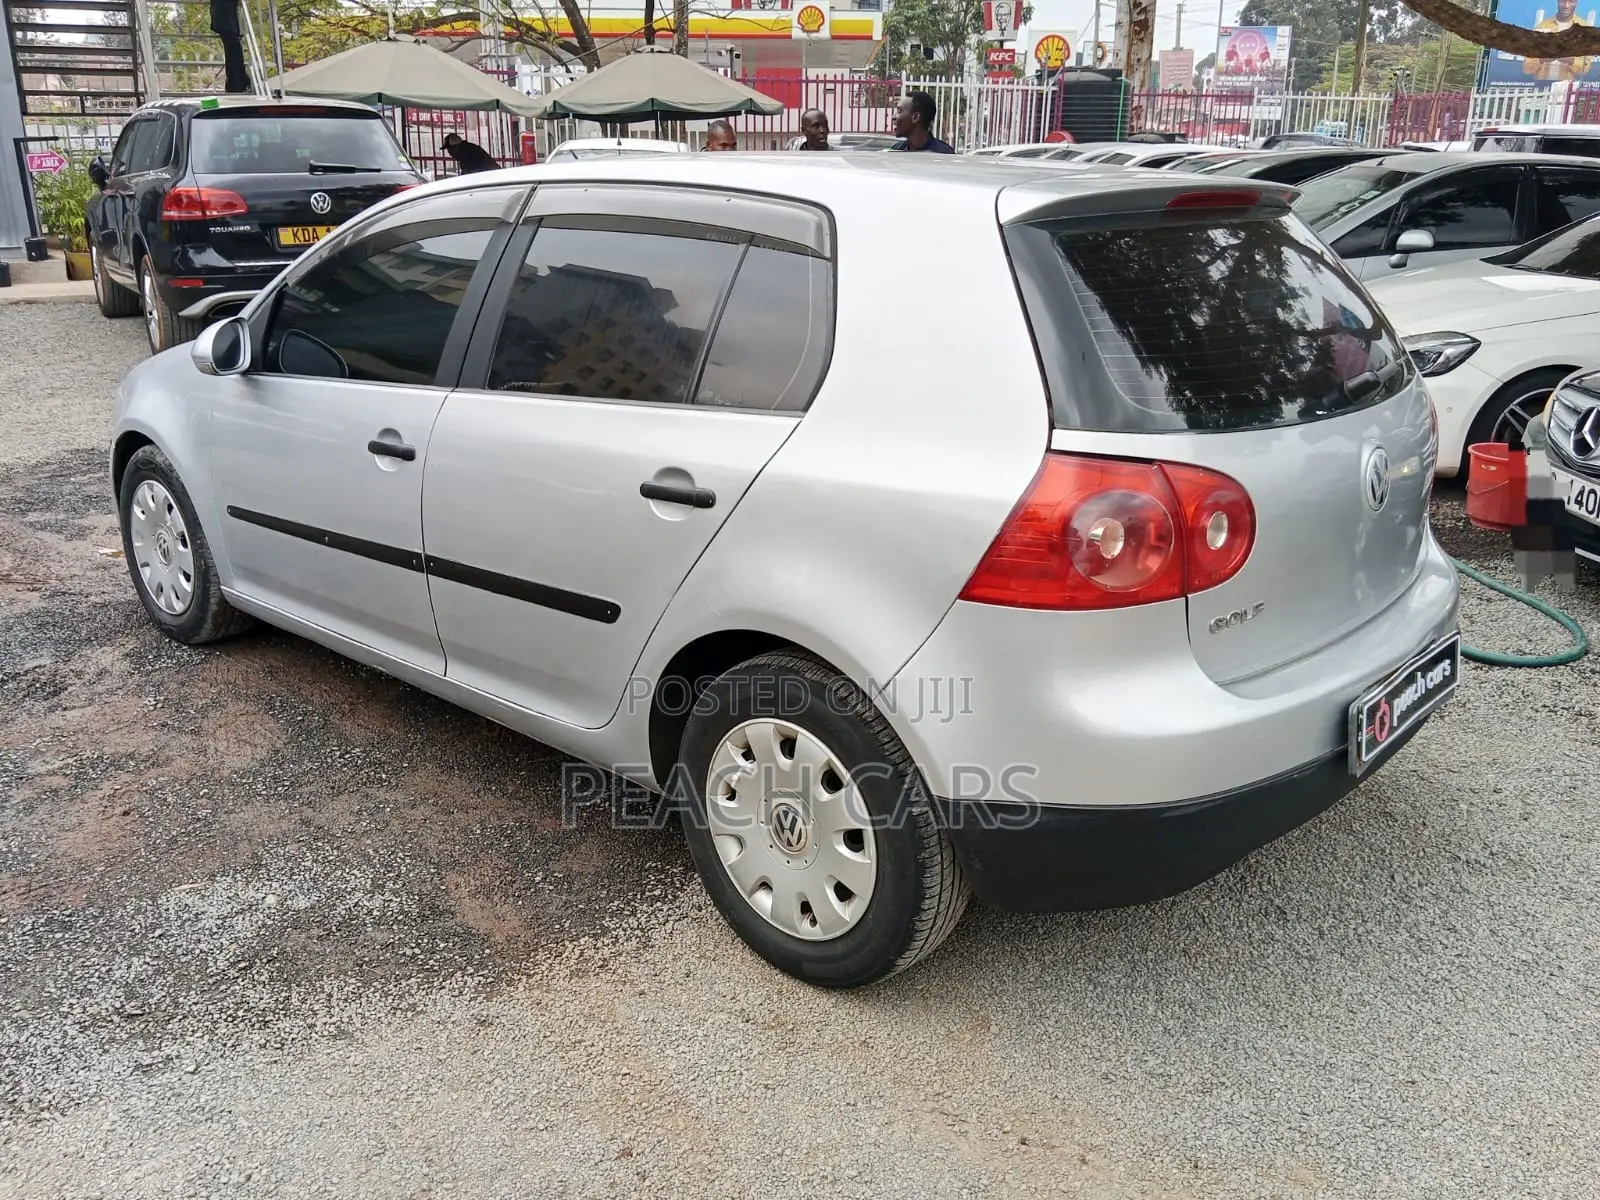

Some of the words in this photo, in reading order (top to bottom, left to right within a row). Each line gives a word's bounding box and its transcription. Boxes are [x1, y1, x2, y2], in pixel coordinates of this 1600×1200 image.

[990, 52, 1014, 61] KFC
[292, 228, 320, 243] KDA
[1209, 600, 1265, 633] GOLF
[1393, 671, 1426, 727] peach
[1426, 659, 1451, 689] cars
